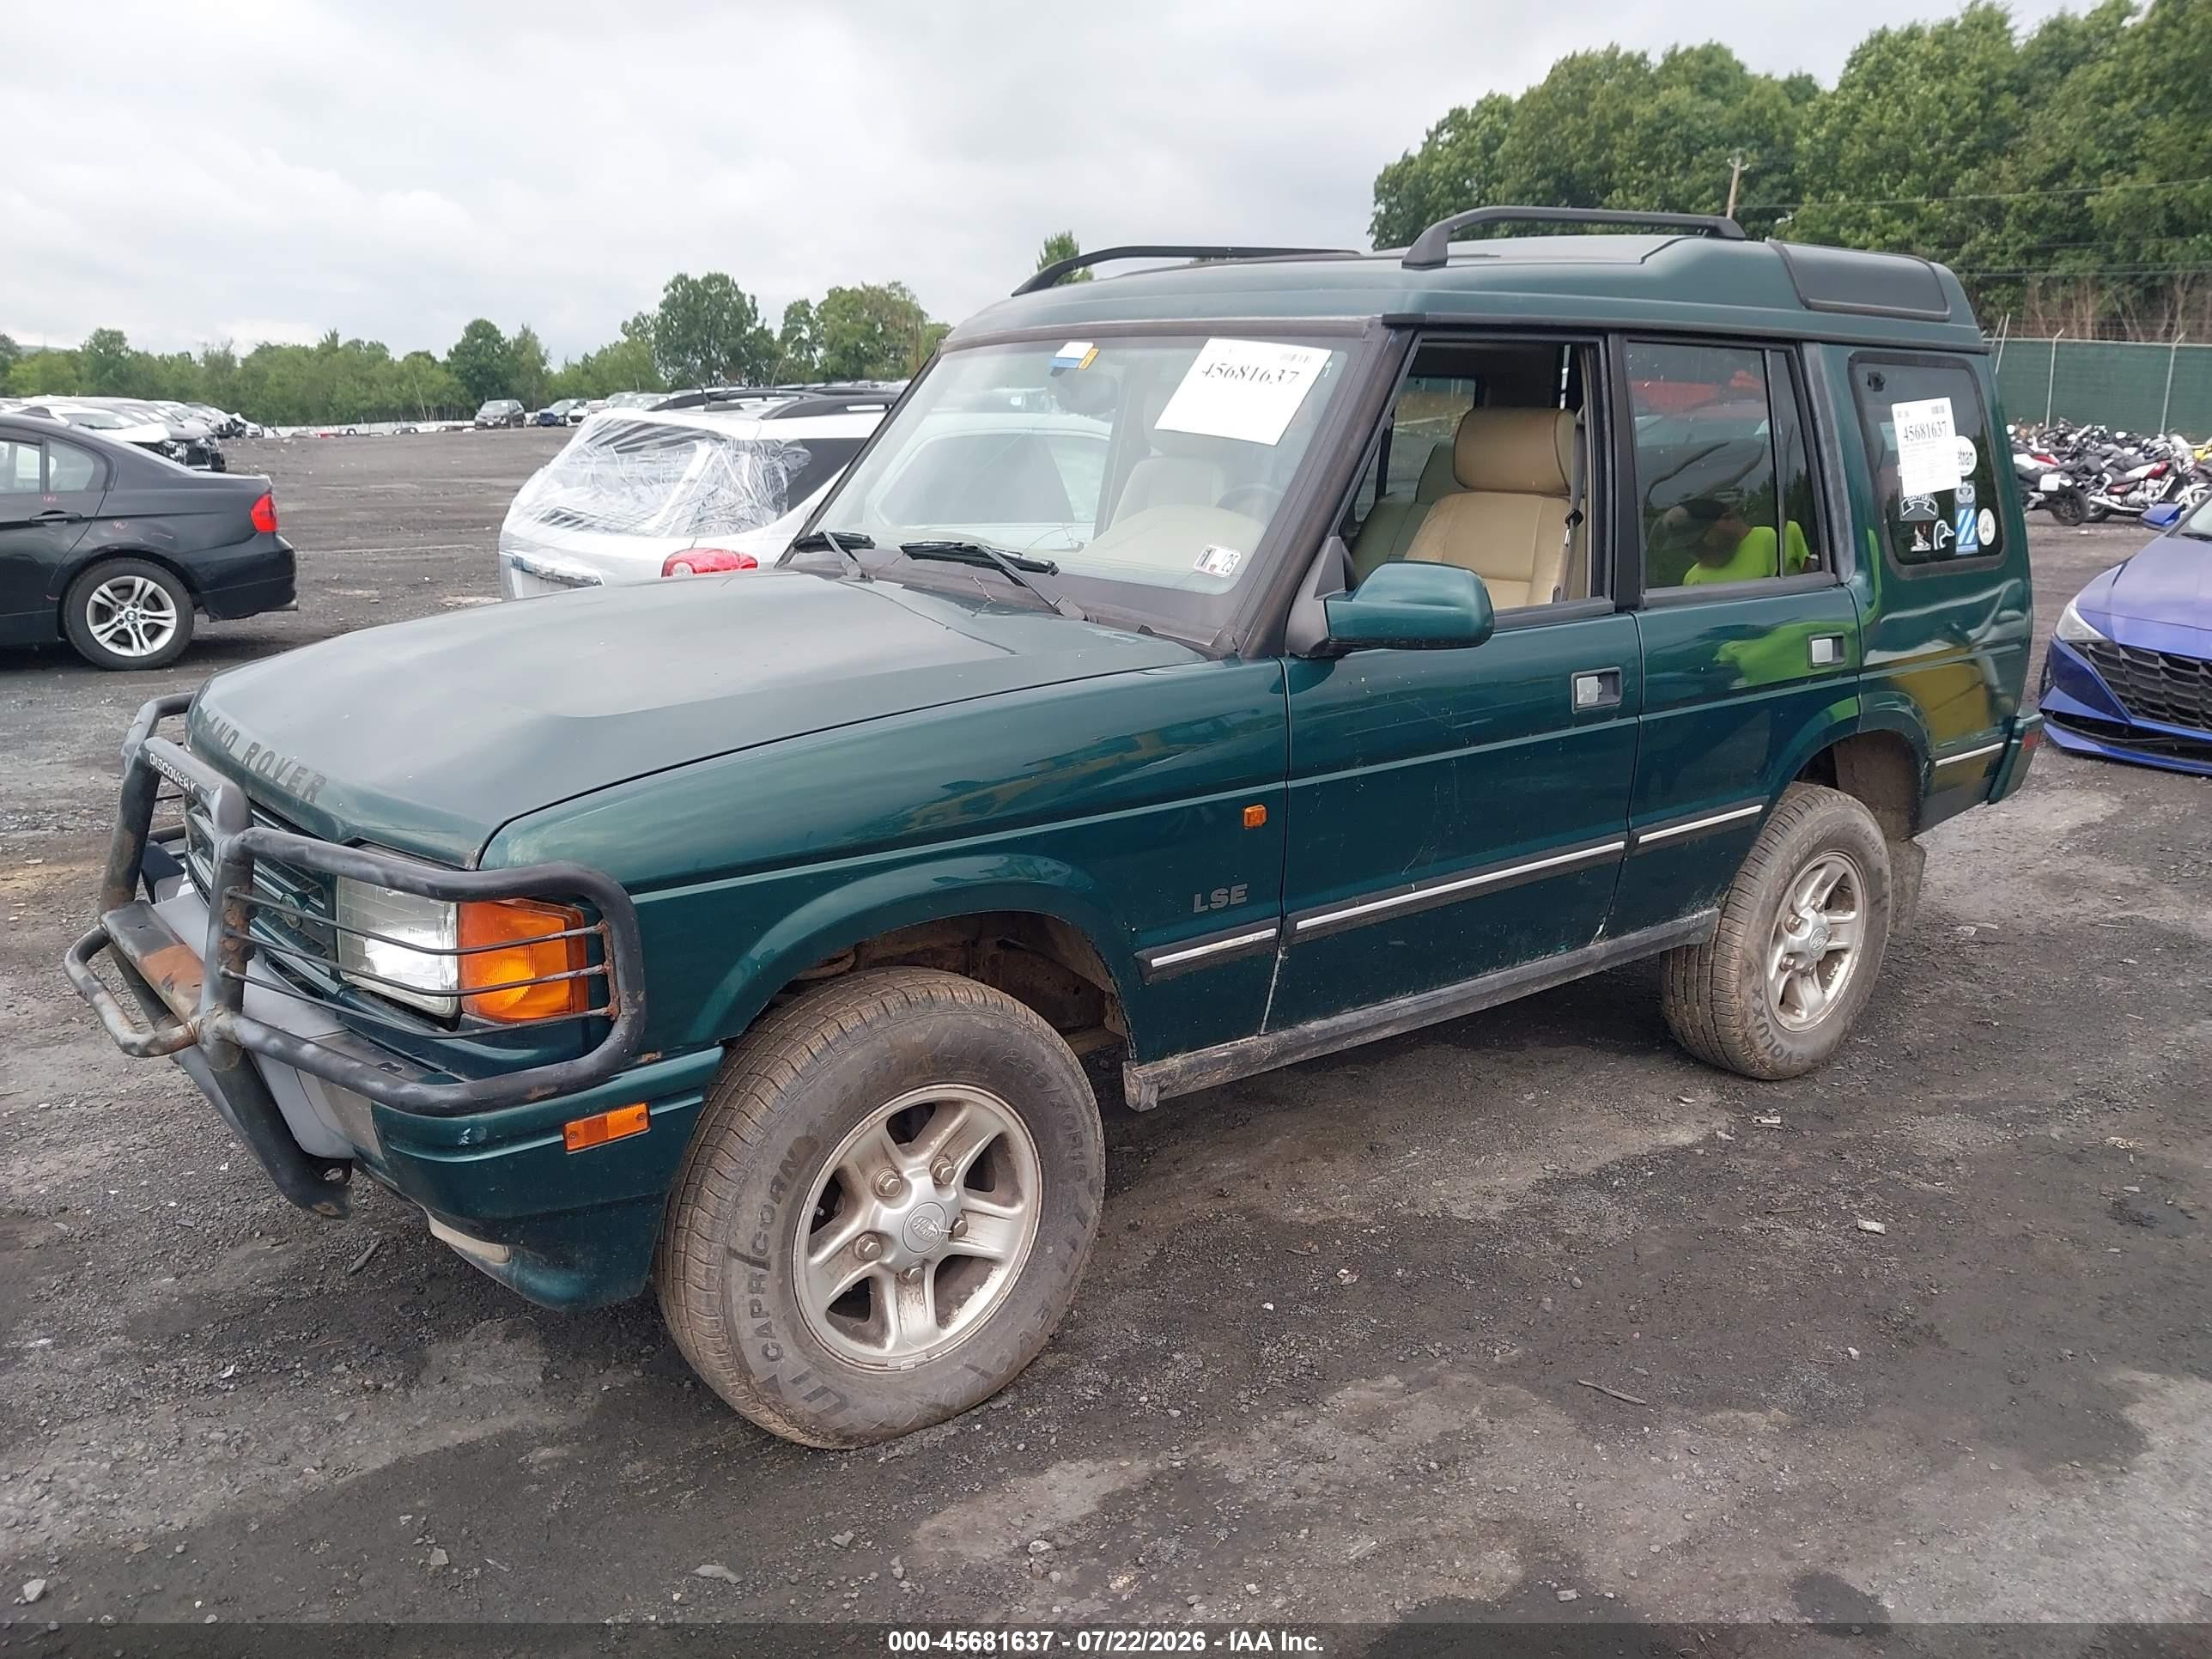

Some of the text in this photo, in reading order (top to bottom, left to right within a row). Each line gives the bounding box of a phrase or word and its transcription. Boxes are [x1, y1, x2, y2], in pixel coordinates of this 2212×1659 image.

[1201, 362, 1300, 385] 45681637
[1903, 420, 1948, 442] 45681637
[149, 752, 198, 794] DISCOVERY
[241, 741, 327, 804] ROVER
[1194, 883, 1249, 914] LSE
[730, 1146, 802, 1364] CAPRICORN
